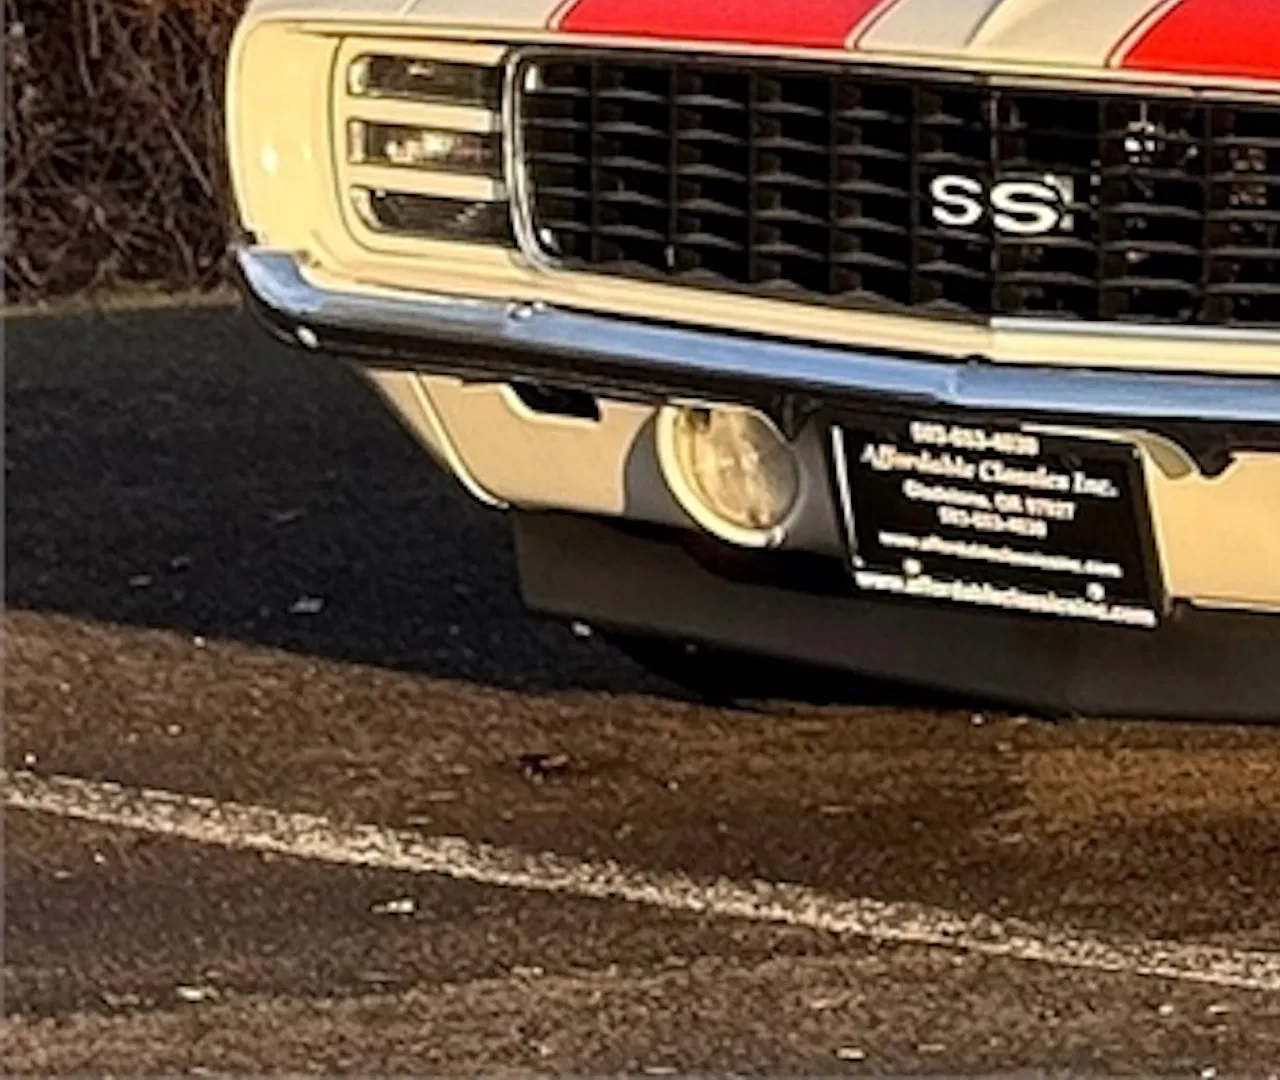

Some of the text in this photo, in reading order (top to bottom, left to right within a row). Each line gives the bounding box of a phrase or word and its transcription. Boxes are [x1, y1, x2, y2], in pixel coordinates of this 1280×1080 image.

[929, 174, 1060, 234] SS
[859, 442, 1121, 498] Affordable Classics Inc.
